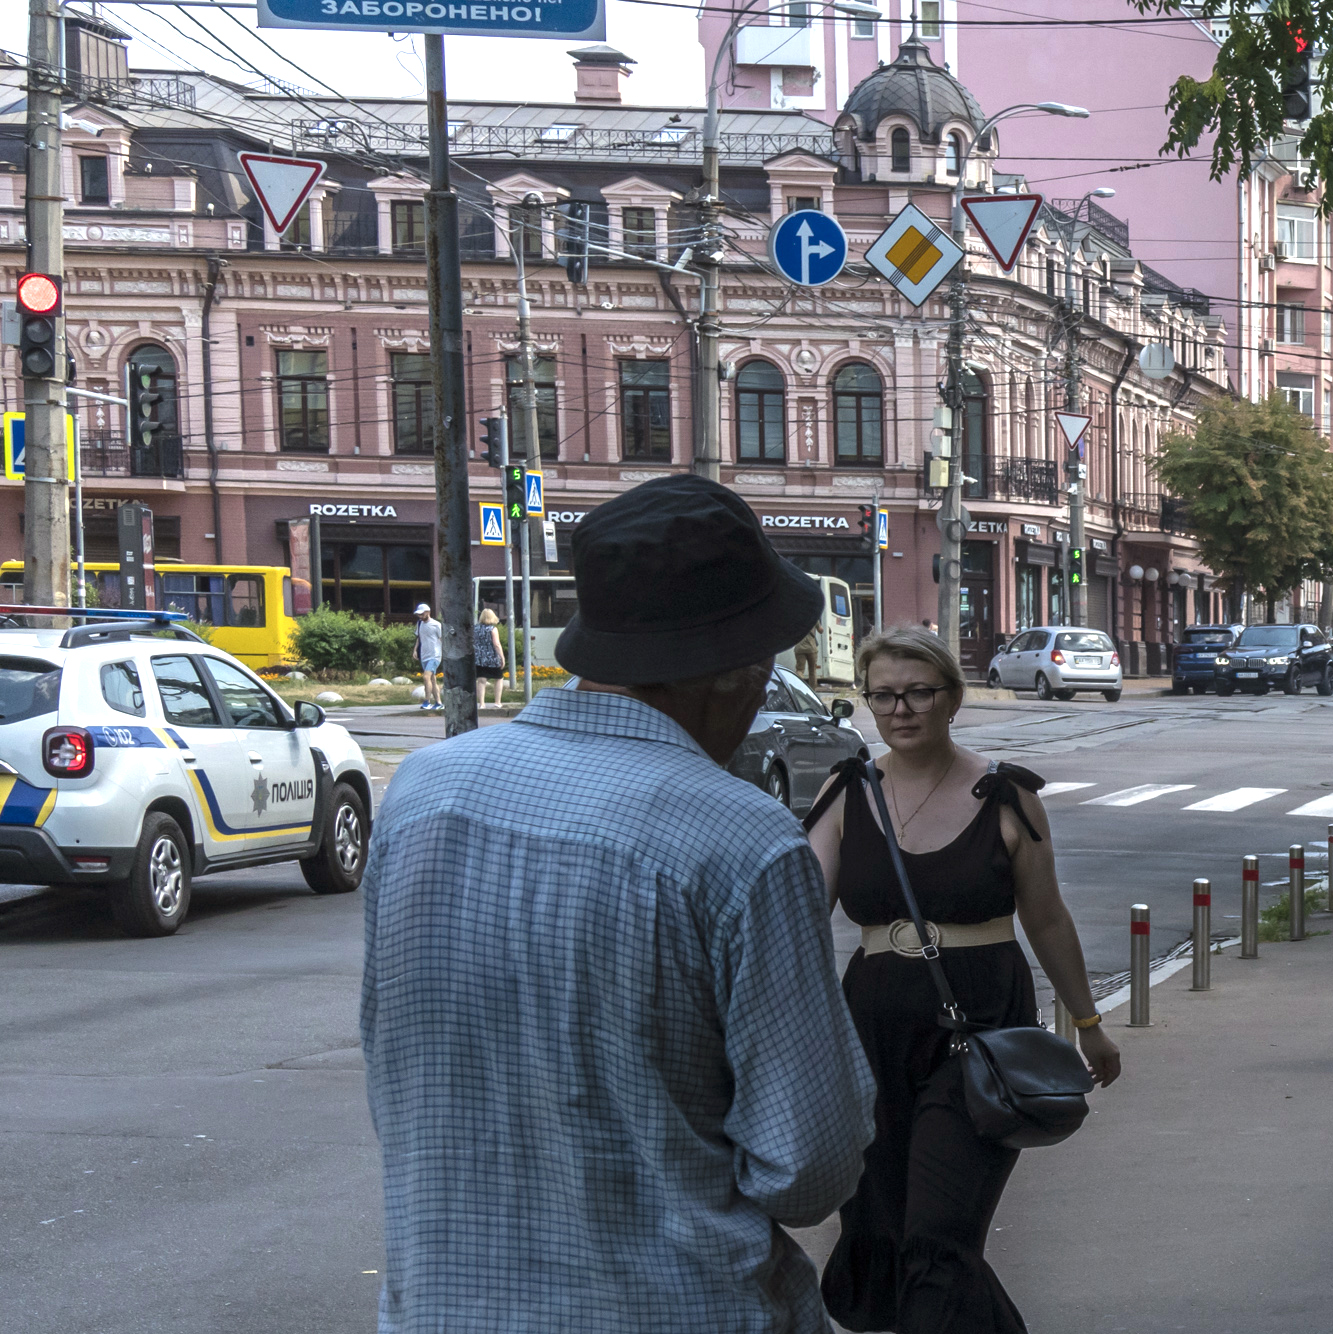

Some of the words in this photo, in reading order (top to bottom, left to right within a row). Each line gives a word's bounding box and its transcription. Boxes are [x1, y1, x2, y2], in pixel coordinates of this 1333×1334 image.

[321, 0, 541, 22] ЗАБОРОНЕНО!
[310, 504, 397, 517] ROZETKA
[548, 511, 589, 523] ROZ
[762, 515, 850, 530] ROZETKA
[115, 728, 135, 745] 102
[272, 779, 314, 804] ПОЛІЦІЯ
